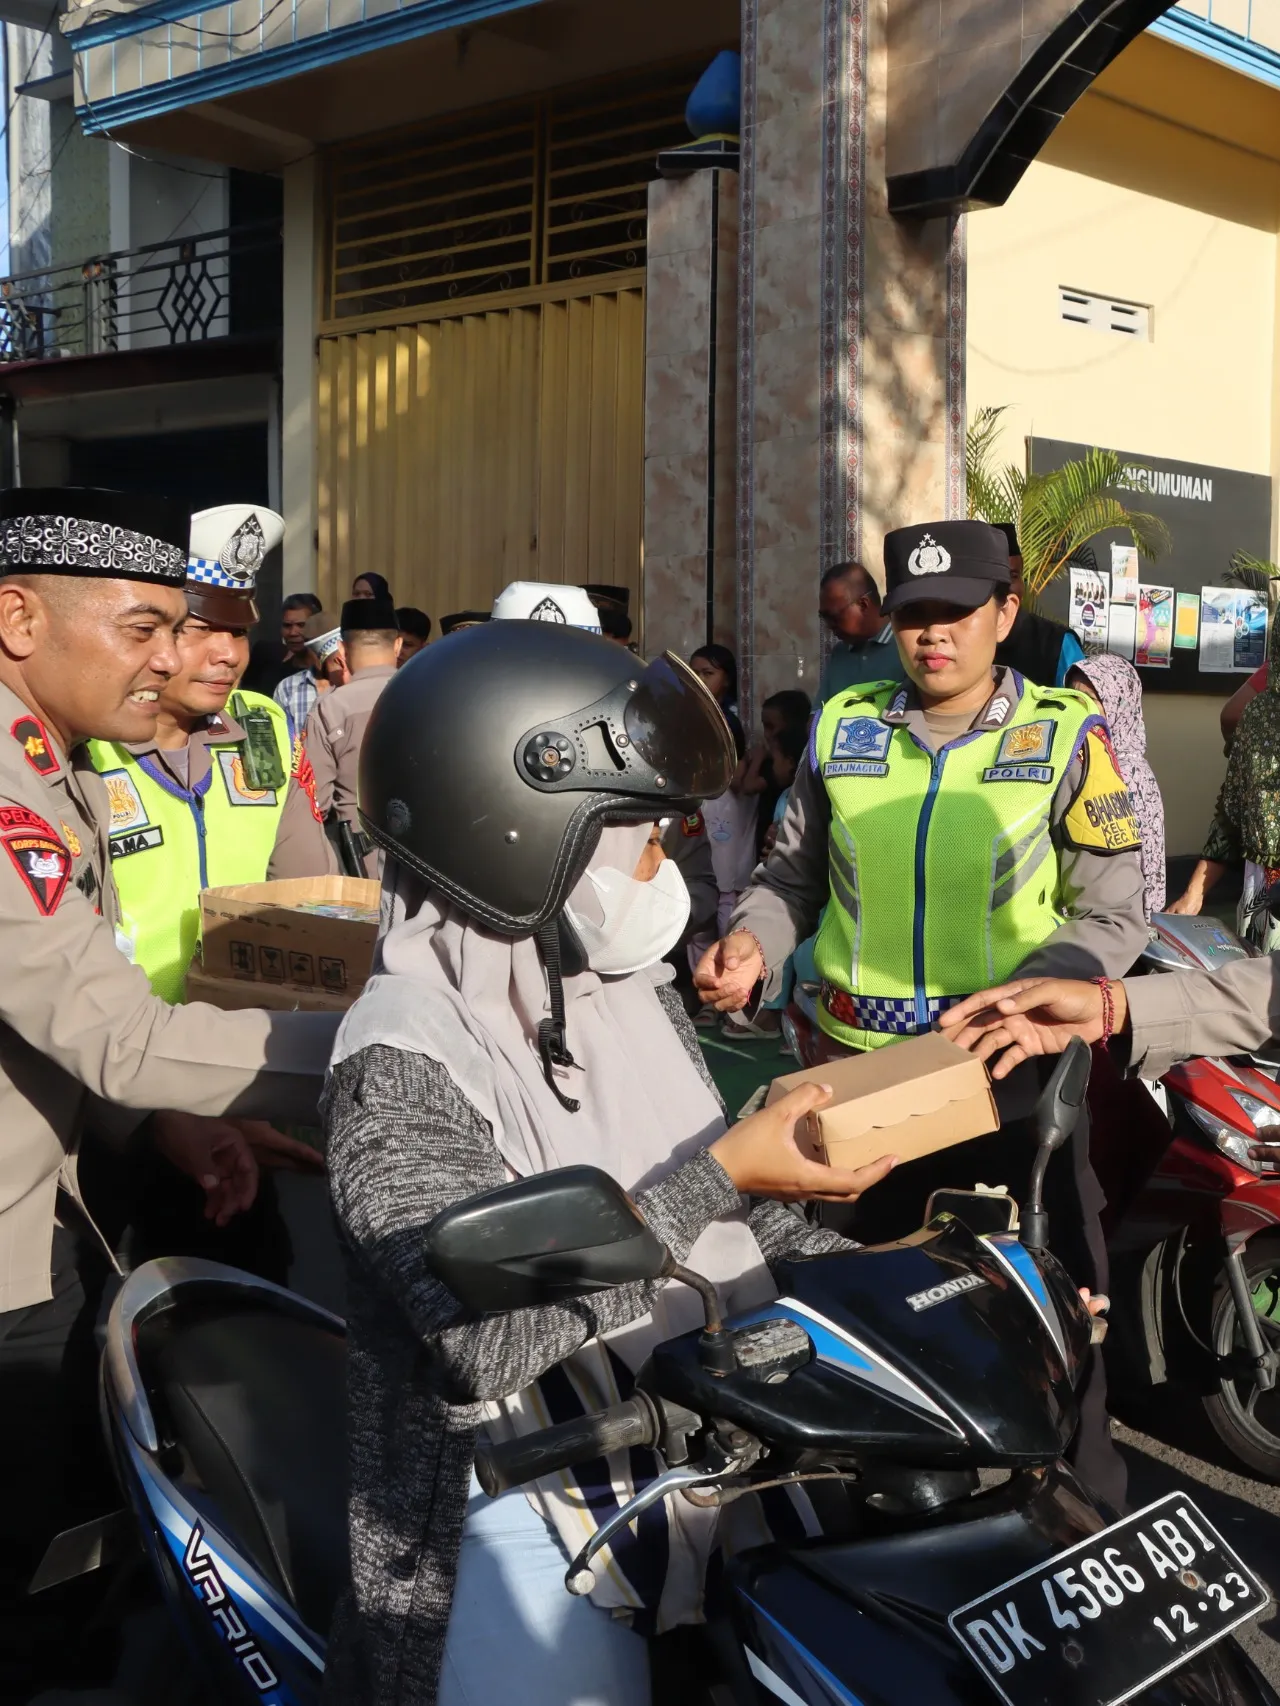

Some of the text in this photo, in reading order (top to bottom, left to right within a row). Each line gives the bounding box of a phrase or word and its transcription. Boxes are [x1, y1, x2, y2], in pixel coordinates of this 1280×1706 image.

[988, 767, 1047, 780] POLRI
[905, 1273, 986, 1313] HONDA
[185, 1527, 279, 1690] VARIO
[965, 1601, 1047, 1674] DK
[1041, 1546, 1146, 1630] 4586
